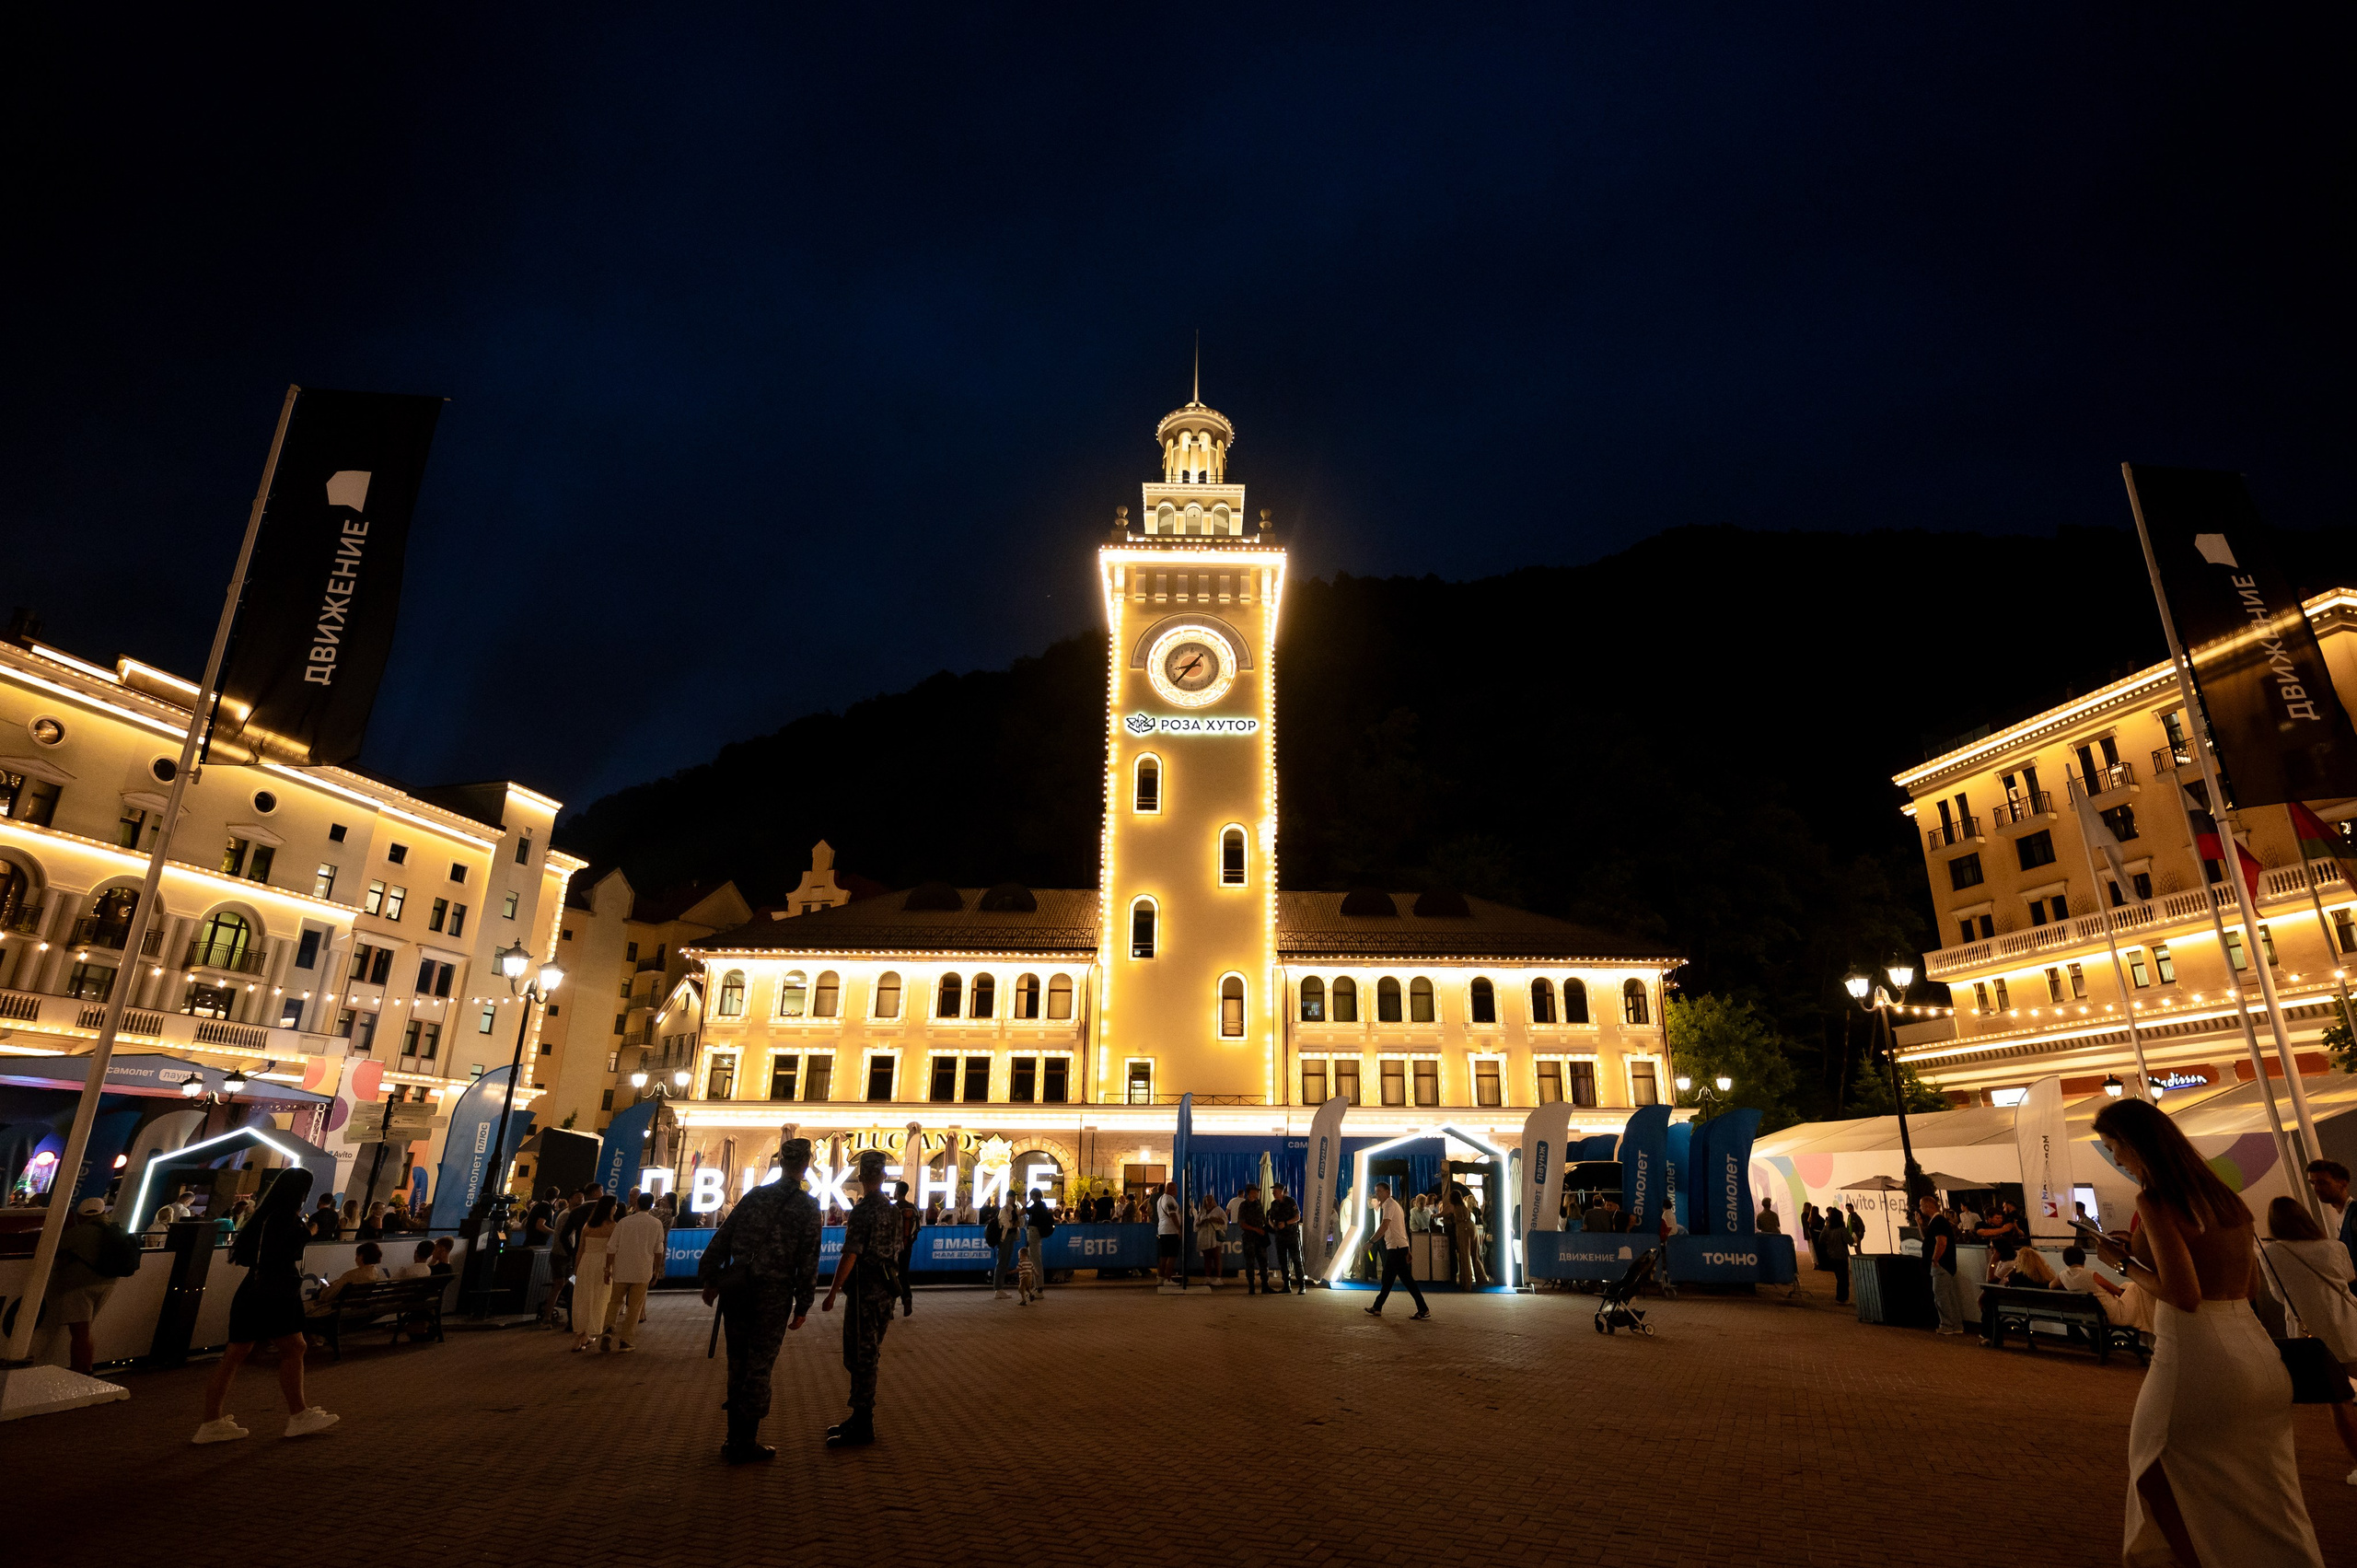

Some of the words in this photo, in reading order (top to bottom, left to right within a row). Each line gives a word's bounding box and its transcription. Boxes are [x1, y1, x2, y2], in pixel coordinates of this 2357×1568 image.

[304, 518, 369, 686] ДВИЖЕНИЕ
[1161, 719, 1201, 731] РОЗА
[1206, 719, 1257, 731] ХУТОР
[107, 1065, 155, 1077] самолет
[2148, 1071, 2207, 1088] adisson
[856, 1132, 971, 1150] LUCANO
[333, 1150, 353, 1159] Avito
[1537, 1144, 1548, 1182] лаунж
[465, 1155, 483, 1208] самолет
[477, 1123, 489, 1152] плюс
[1312, 1184, 1323, 1229] самолет
[1319, 1141, 1328, 1177] лаунж
[1634, 1150, 1649, 1226] самолет
[1726, 1153, 1739, 1233] самолет
[1845, 1193, 1875, 1211] Avito
[1084, 1238, 1118, 1255] ВТБ
[1559, 1252, 1616, 1262] ДВИЖЕНИЕ
